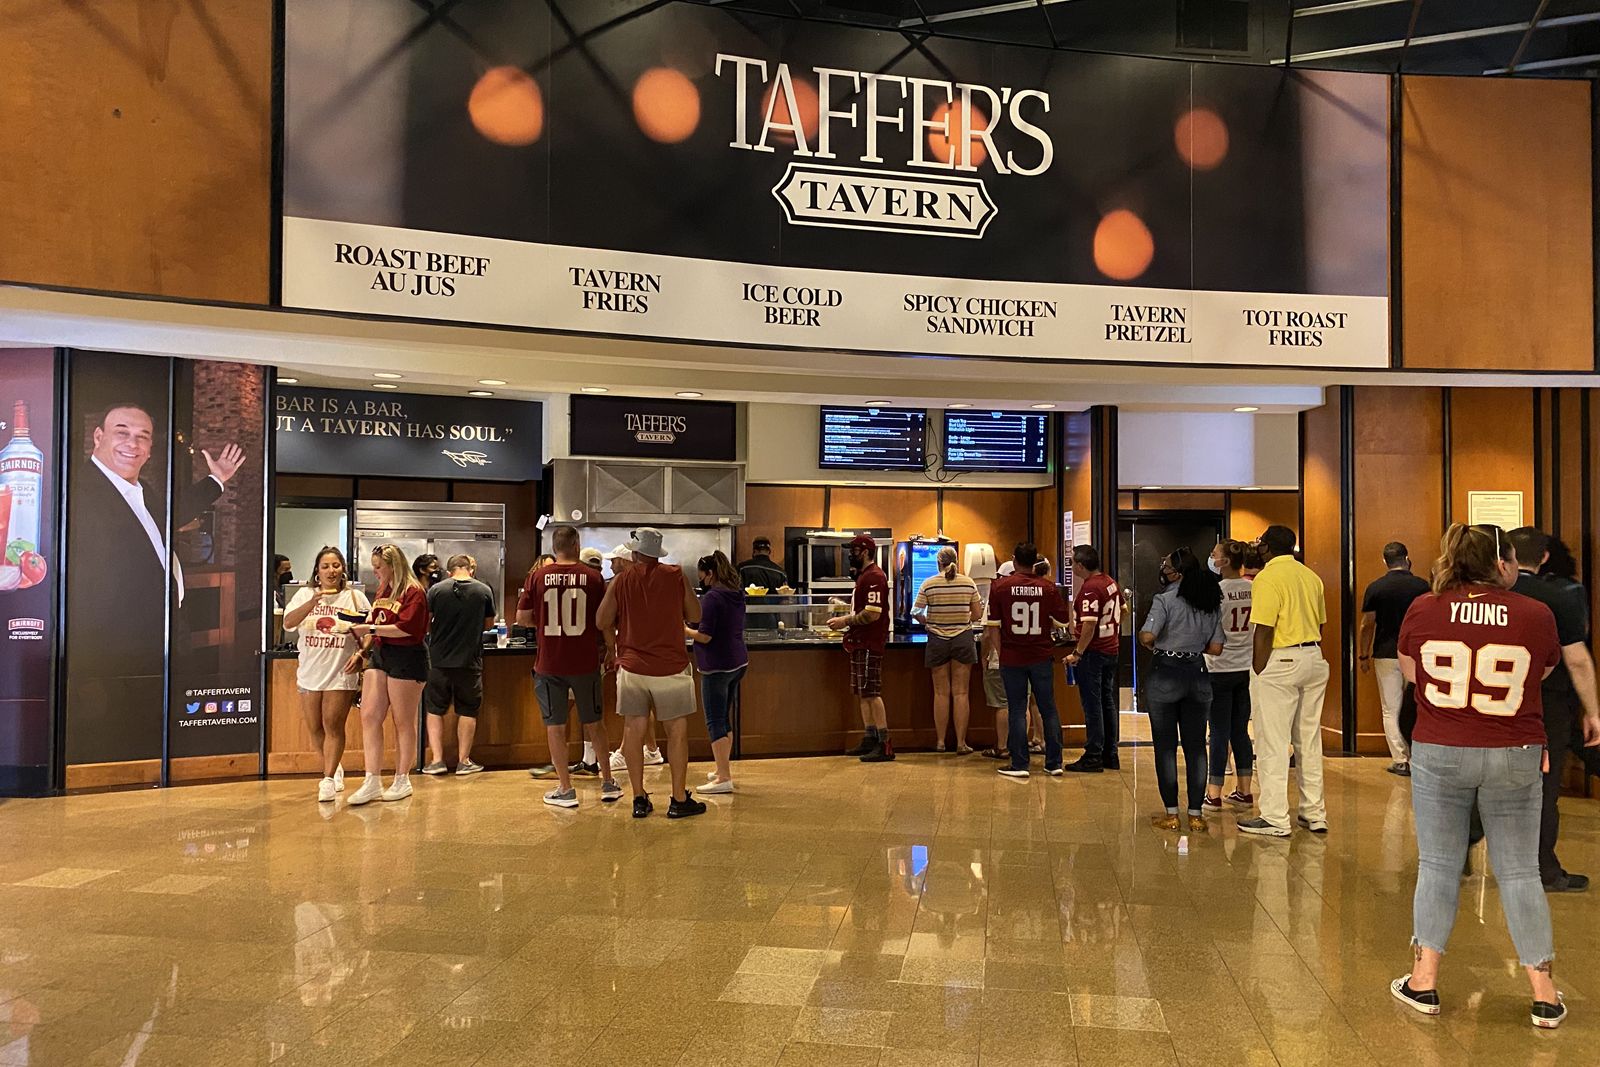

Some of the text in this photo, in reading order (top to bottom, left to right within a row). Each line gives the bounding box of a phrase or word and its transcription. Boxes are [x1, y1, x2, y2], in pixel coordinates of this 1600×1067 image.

[714, 53, 1054, 176] TAFFER'S
[800, 180, 975, 223] TAVERN
[334, 243, 491, 277] ROAST BEEF
[371, 271, 456, 297] AU JUS
[569, 267, 662, 293] TAVERN
[582, 290, 648, 314] FRIES
[742, 283, 843, 307] ICE COLD
[903, 293, 1058, 318] SPICY CHICKEN
[764, 306, 821, 327] BEER
[1110, 304, 1187, 324] TAVERN
[1243, 309, 1348, 329] TOT ROAST
[927, 315, 1034, 337] SANDWICH
[1105, 324, 1192, 343] PRETZEL
[1269, 330, 1323, 347] FRIES
[276, 395, 408, 420] BAR IS A BAR,
[300, 416, 314, 433] A
[319, 418, 401, 438] TAVERN
[407, 423, 445, 440] HAS
[624, 413, 687, 433] TAFFER'S
[639, 433, 672, 441] TAVERN
[0, 458, 40, 471] SMIRNOFF
[544, 573, 587, 586] GRIFFIN III
[867, 591, 881, 603] 91
[1011, 586, 1043, 597] KERRIGAN
[544, 588, 587, 636] 10
[1011, 601, 1042, 635] 91
[1230, 606, 1252, 632] 17
[1450, 602, 1508, 626] YOUNG
[305, 635, 345, 649] FOOTBALL
[1419, 640, 1532, 717] 99
[185, 687, 251, 697] @TAFFERTAVERN
[179, 717, 258, 728] TAFFERTAVERN.COM
